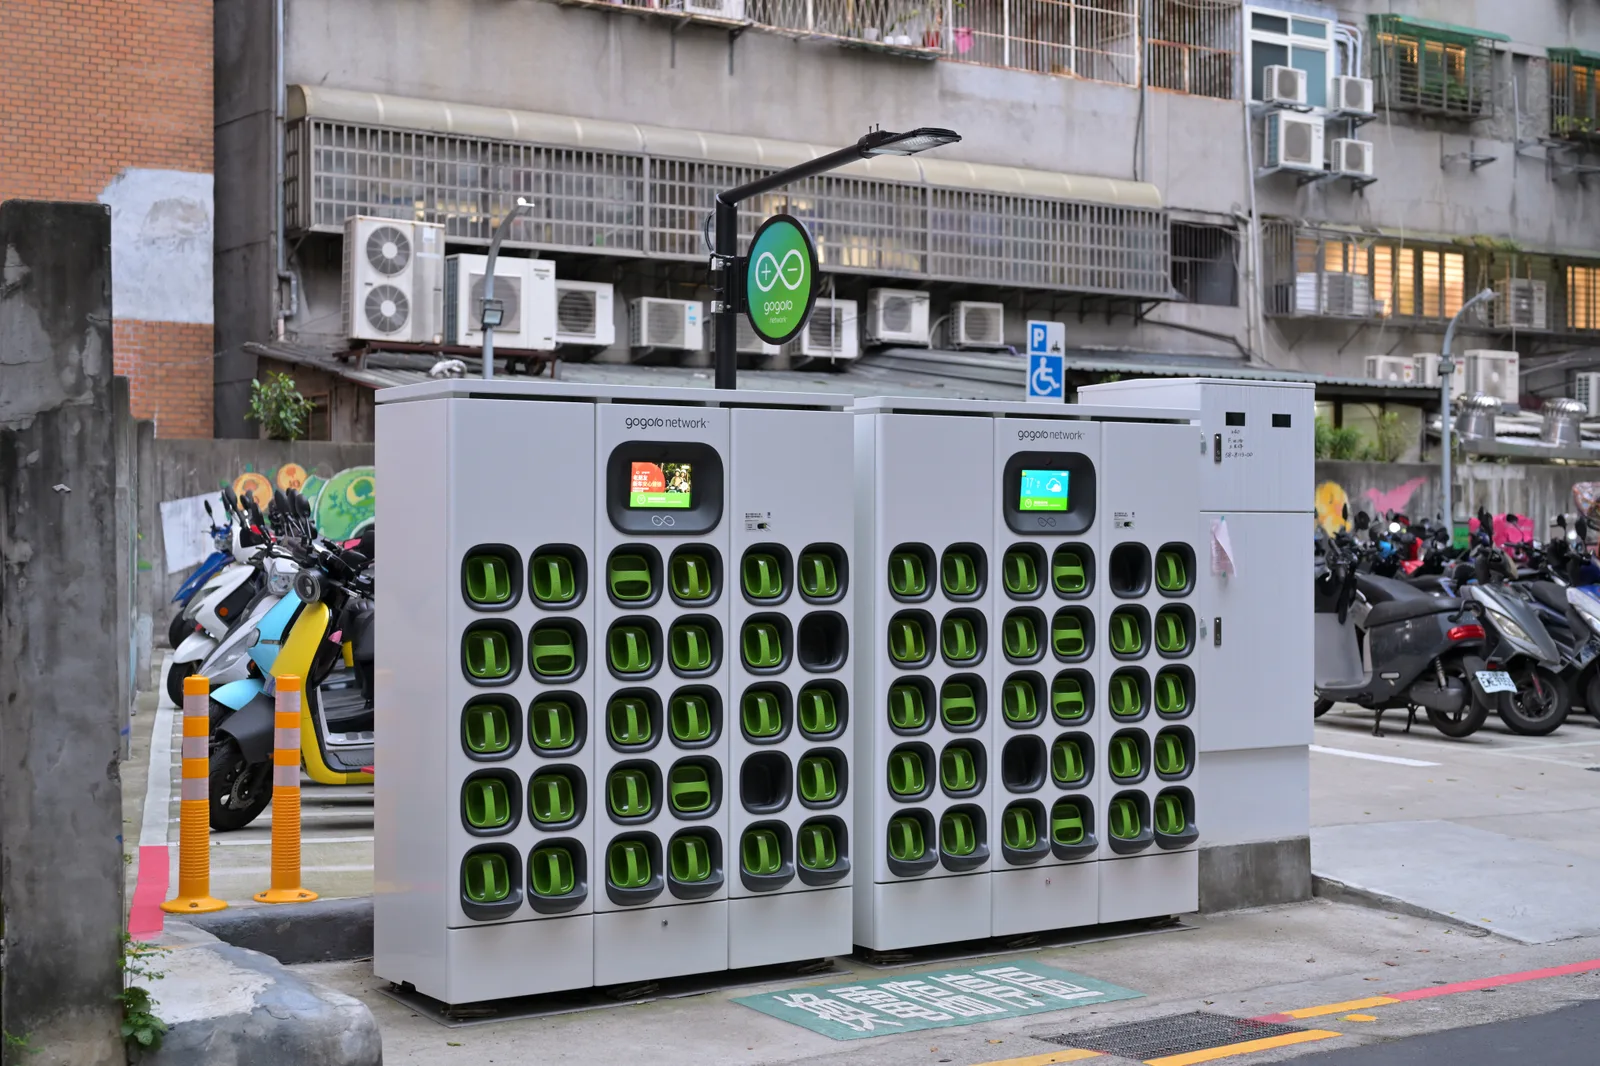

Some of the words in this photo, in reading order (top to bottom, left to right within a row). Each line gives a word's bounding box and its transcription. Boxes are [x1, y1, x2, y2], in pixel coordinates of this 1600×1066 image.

[763, 300, 793, 315] gogoro
[1033, 328, 1044, 347] P
[625, 417, 664, 430] gogoro
[1018, 430, 1048, 440] gogoro
[773, 966, 1104, 1032] 換電臨停區
